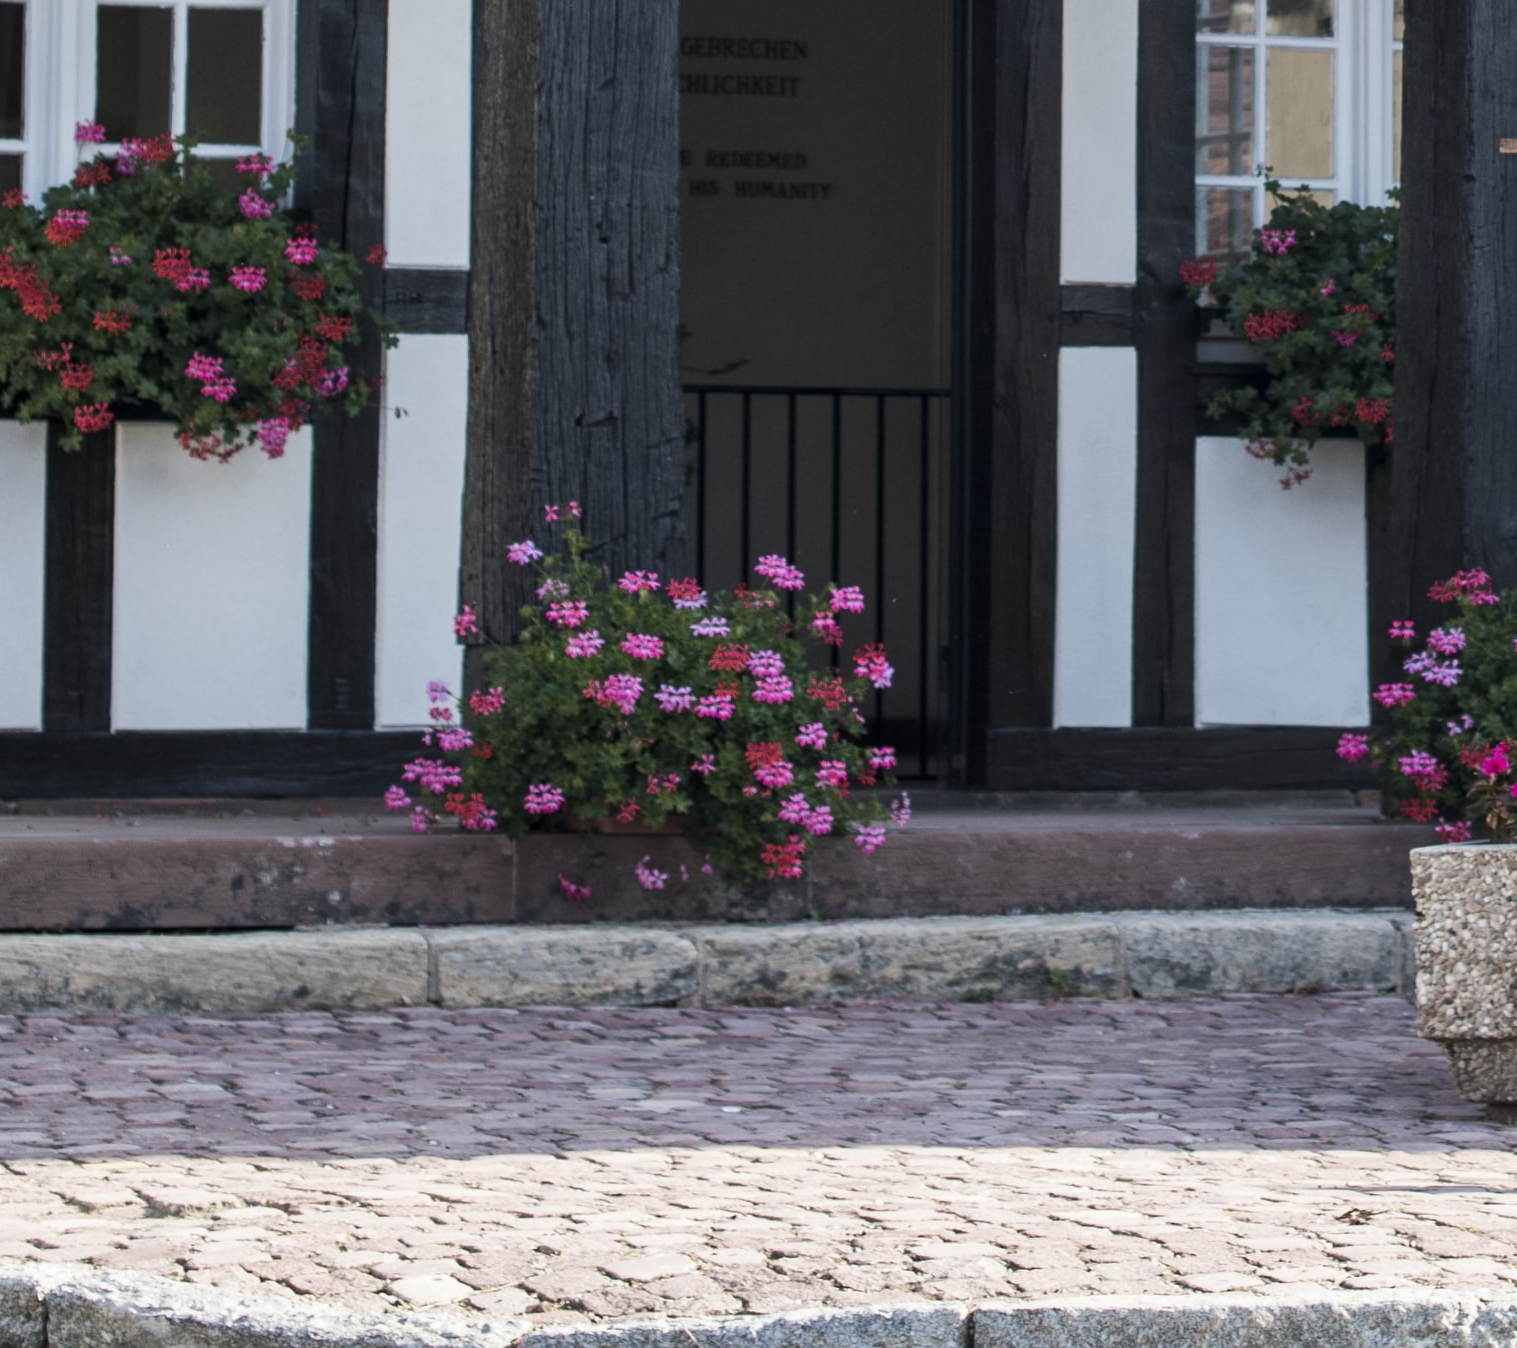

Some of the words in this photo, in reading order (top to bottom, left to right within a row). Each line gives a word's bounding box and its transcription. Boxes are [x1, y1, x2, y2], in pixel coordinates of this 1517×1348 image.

[680, 37, 808, 60] GEBRECHEN
[679, 74, 800, 97] CHLICHKEIT
[706, 151, 807, 170] REDEEMED
[689, 179, 720, 197] HIS
[734, 180, 832, 200] HUMANITY
